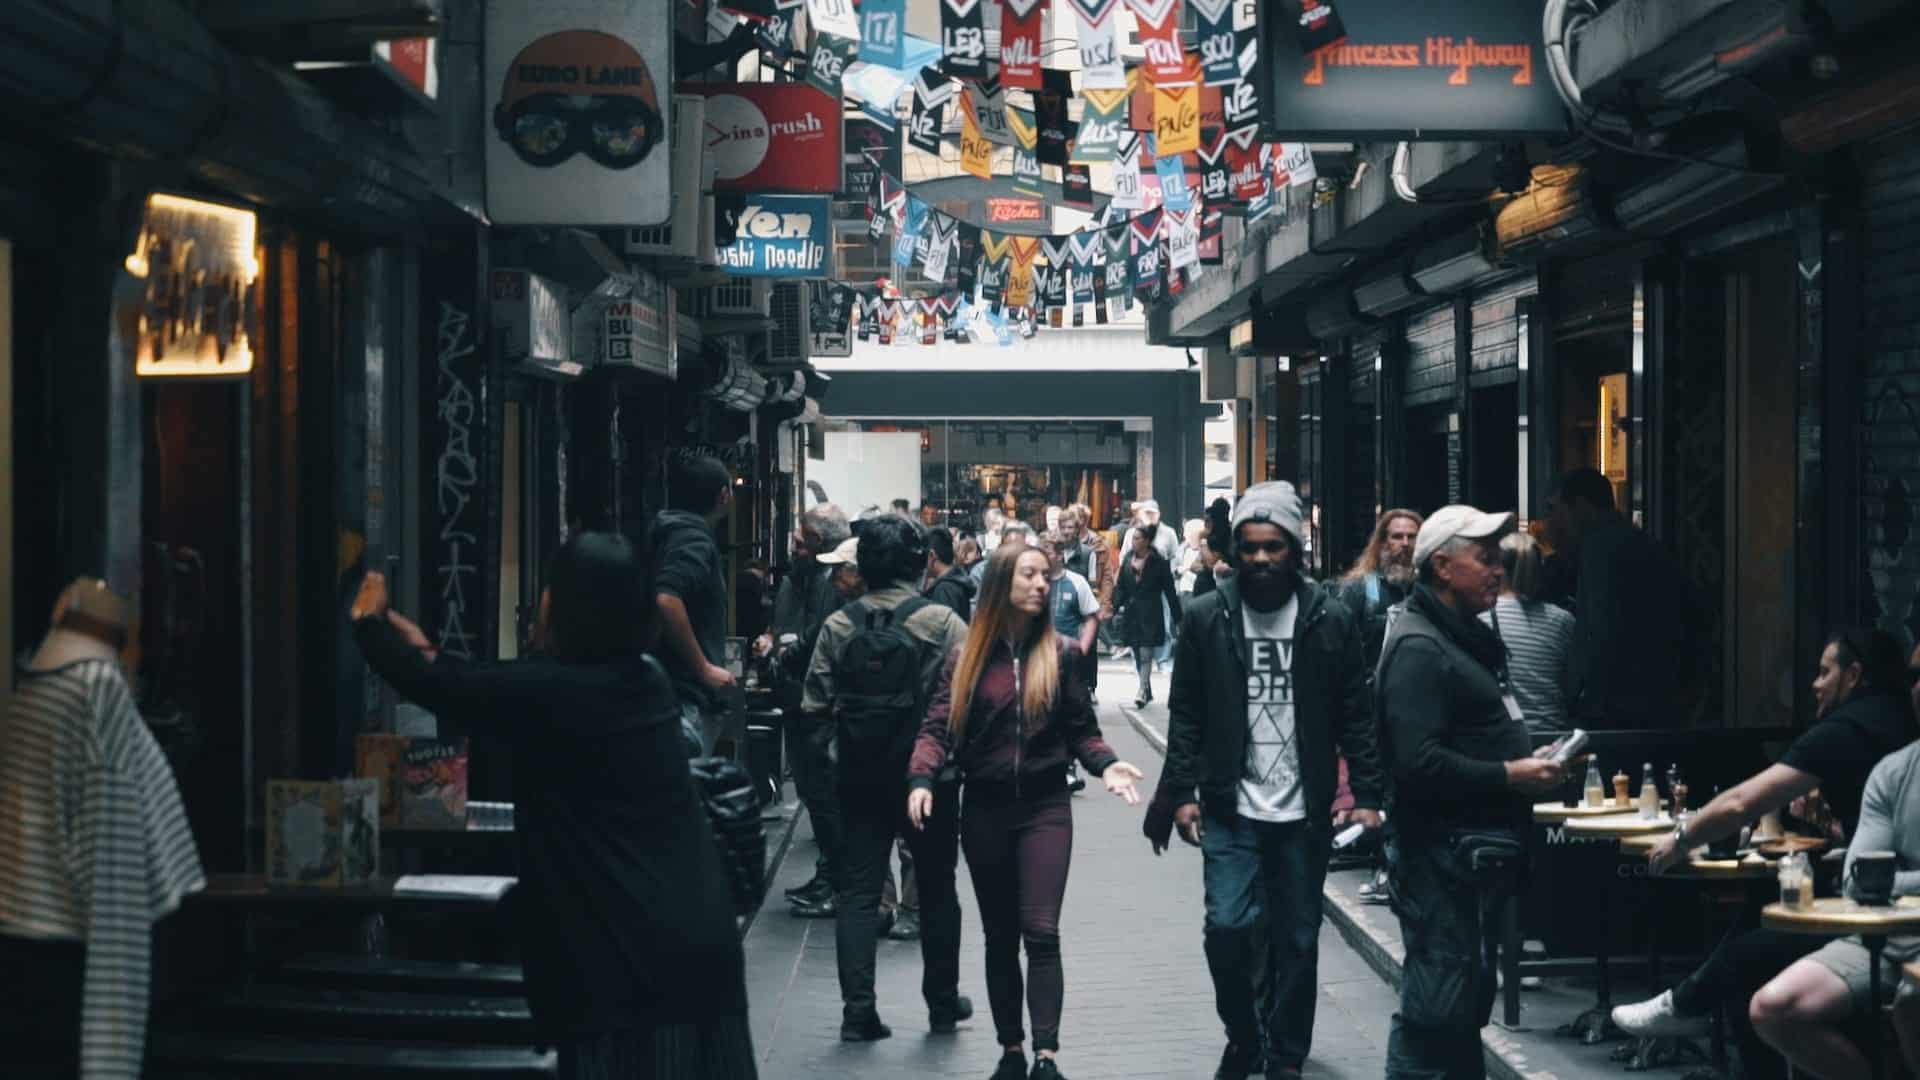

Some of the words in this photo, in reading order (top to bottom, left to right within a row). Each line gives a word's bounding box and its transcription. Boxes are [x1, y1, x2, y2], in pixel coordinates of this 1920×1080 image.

[865, 12, 897, 47] ITA
[944, 27, 985, 60] LEB
[812, 46, 843, 80] IRE
[1424, 36, 1533, 84] Highway
[770, 112, 821, 137] rush
[1079, 118, 1120, 145] AUS
[1157, 102, 1196, 140] PNG
[1203, 168, 1227, 196] LEB
[714, 239, 753, 267] ushi
[764, 239, 824, 270] noodle
